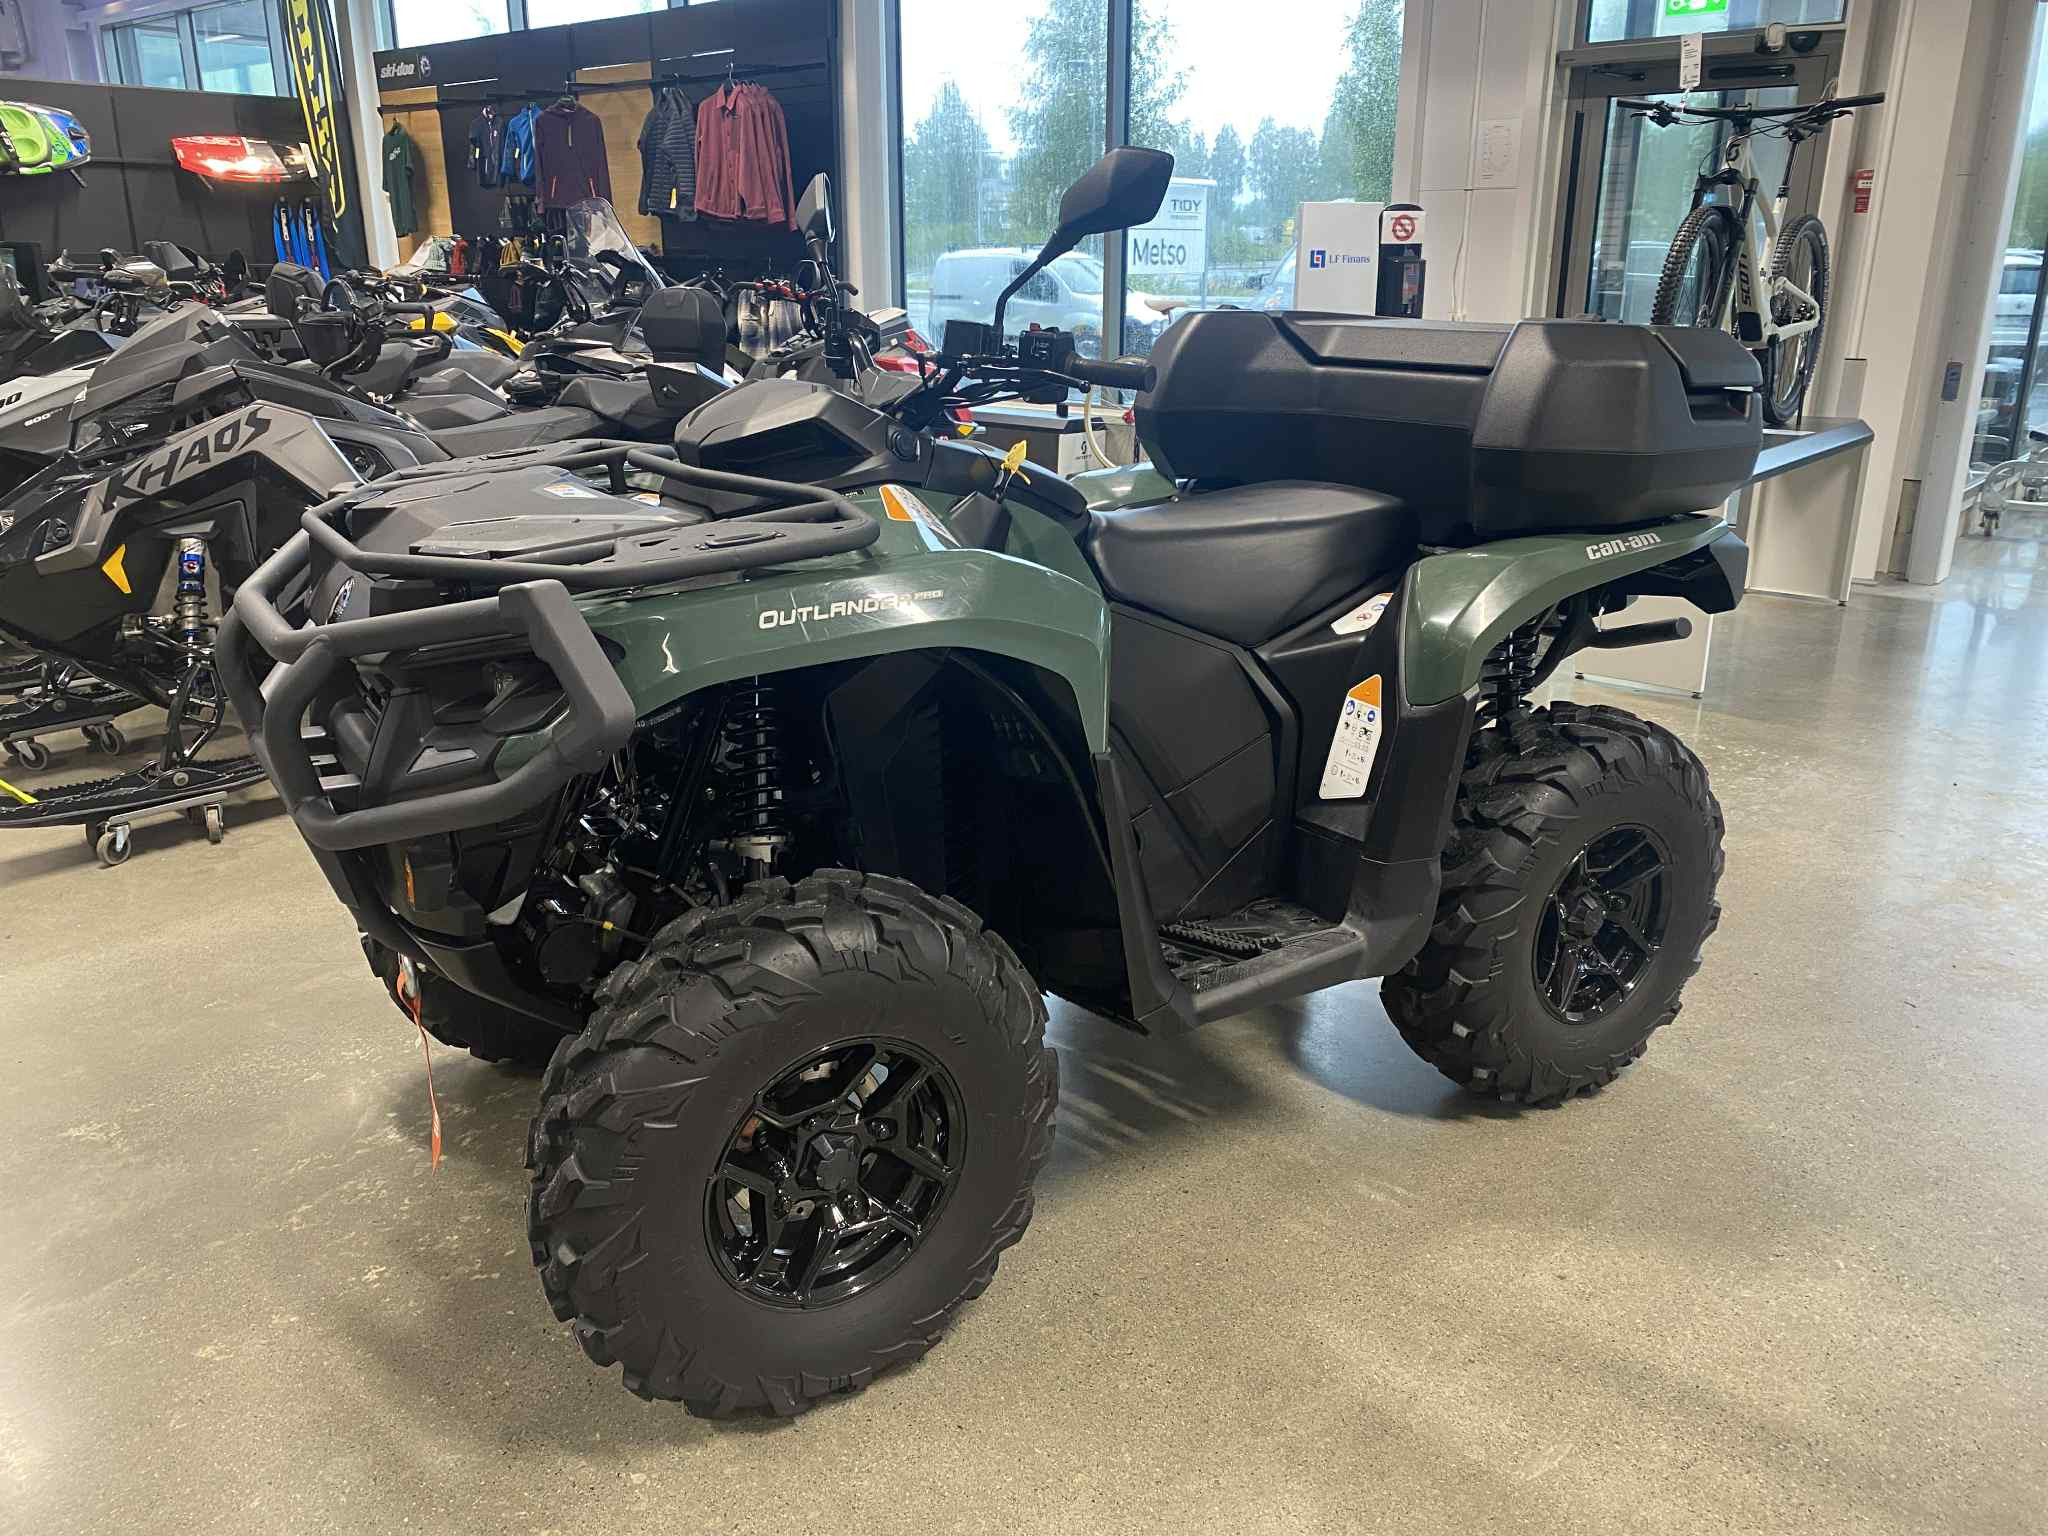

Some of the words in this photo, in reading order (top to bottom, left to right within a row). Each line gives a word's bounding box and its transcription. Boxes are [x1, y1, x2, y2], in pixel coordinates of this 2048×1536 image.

[380, 62, 415, 78] ski-doo
[1170, 199, 1202, 212] TIDY
[1132, 238, 1187, 266] Metso
[1342, 254, 1371, 264] Finans
[97, 405, 272, 514] KHAOS
[1585, 532, 1662, 560] can-am
[758, 593, 912, 630] OUTLANDER
